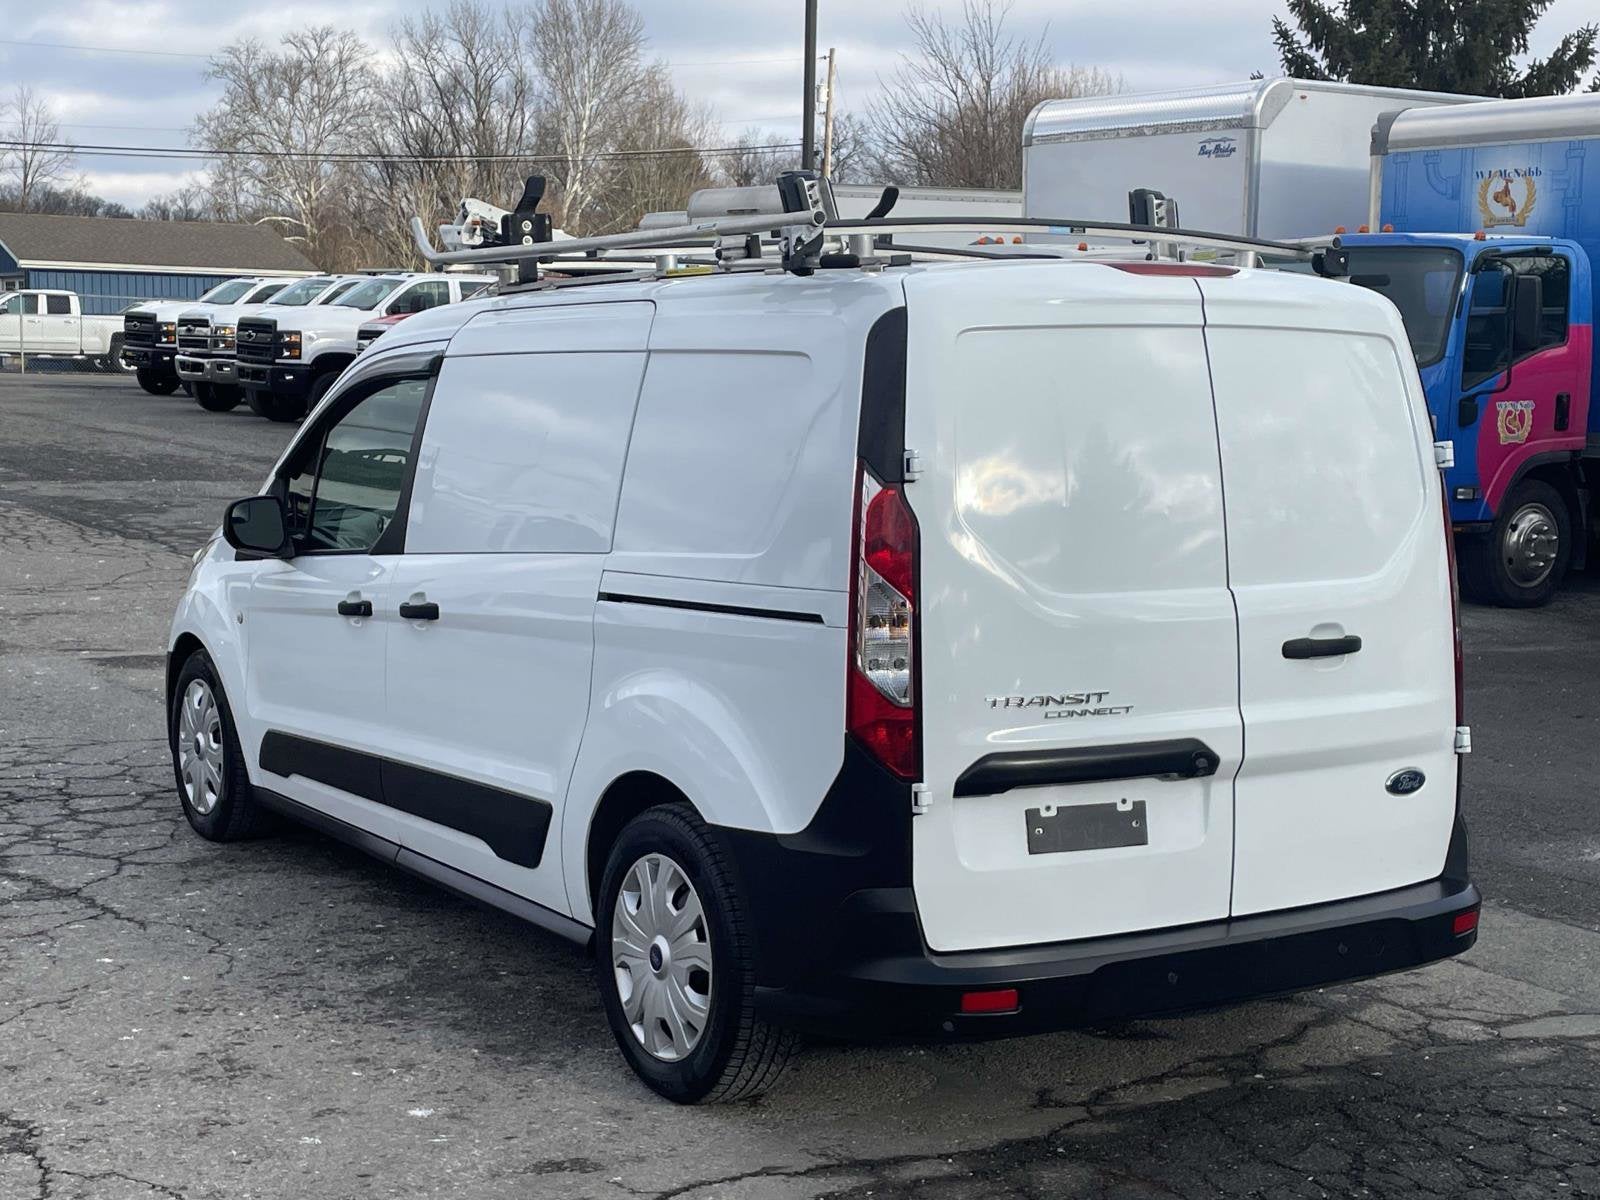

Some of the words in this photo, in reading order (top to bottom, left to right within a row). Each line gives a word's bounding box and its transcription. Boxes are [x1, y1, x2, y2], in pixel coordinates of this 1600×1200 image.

[1498, 166, 1543, 179] McNabb
[985, 691, 1110, 709] TRANSIT
[1044, 705, 1134, 720] CONNECT
[1398, 774, 1421, 790] Ford
